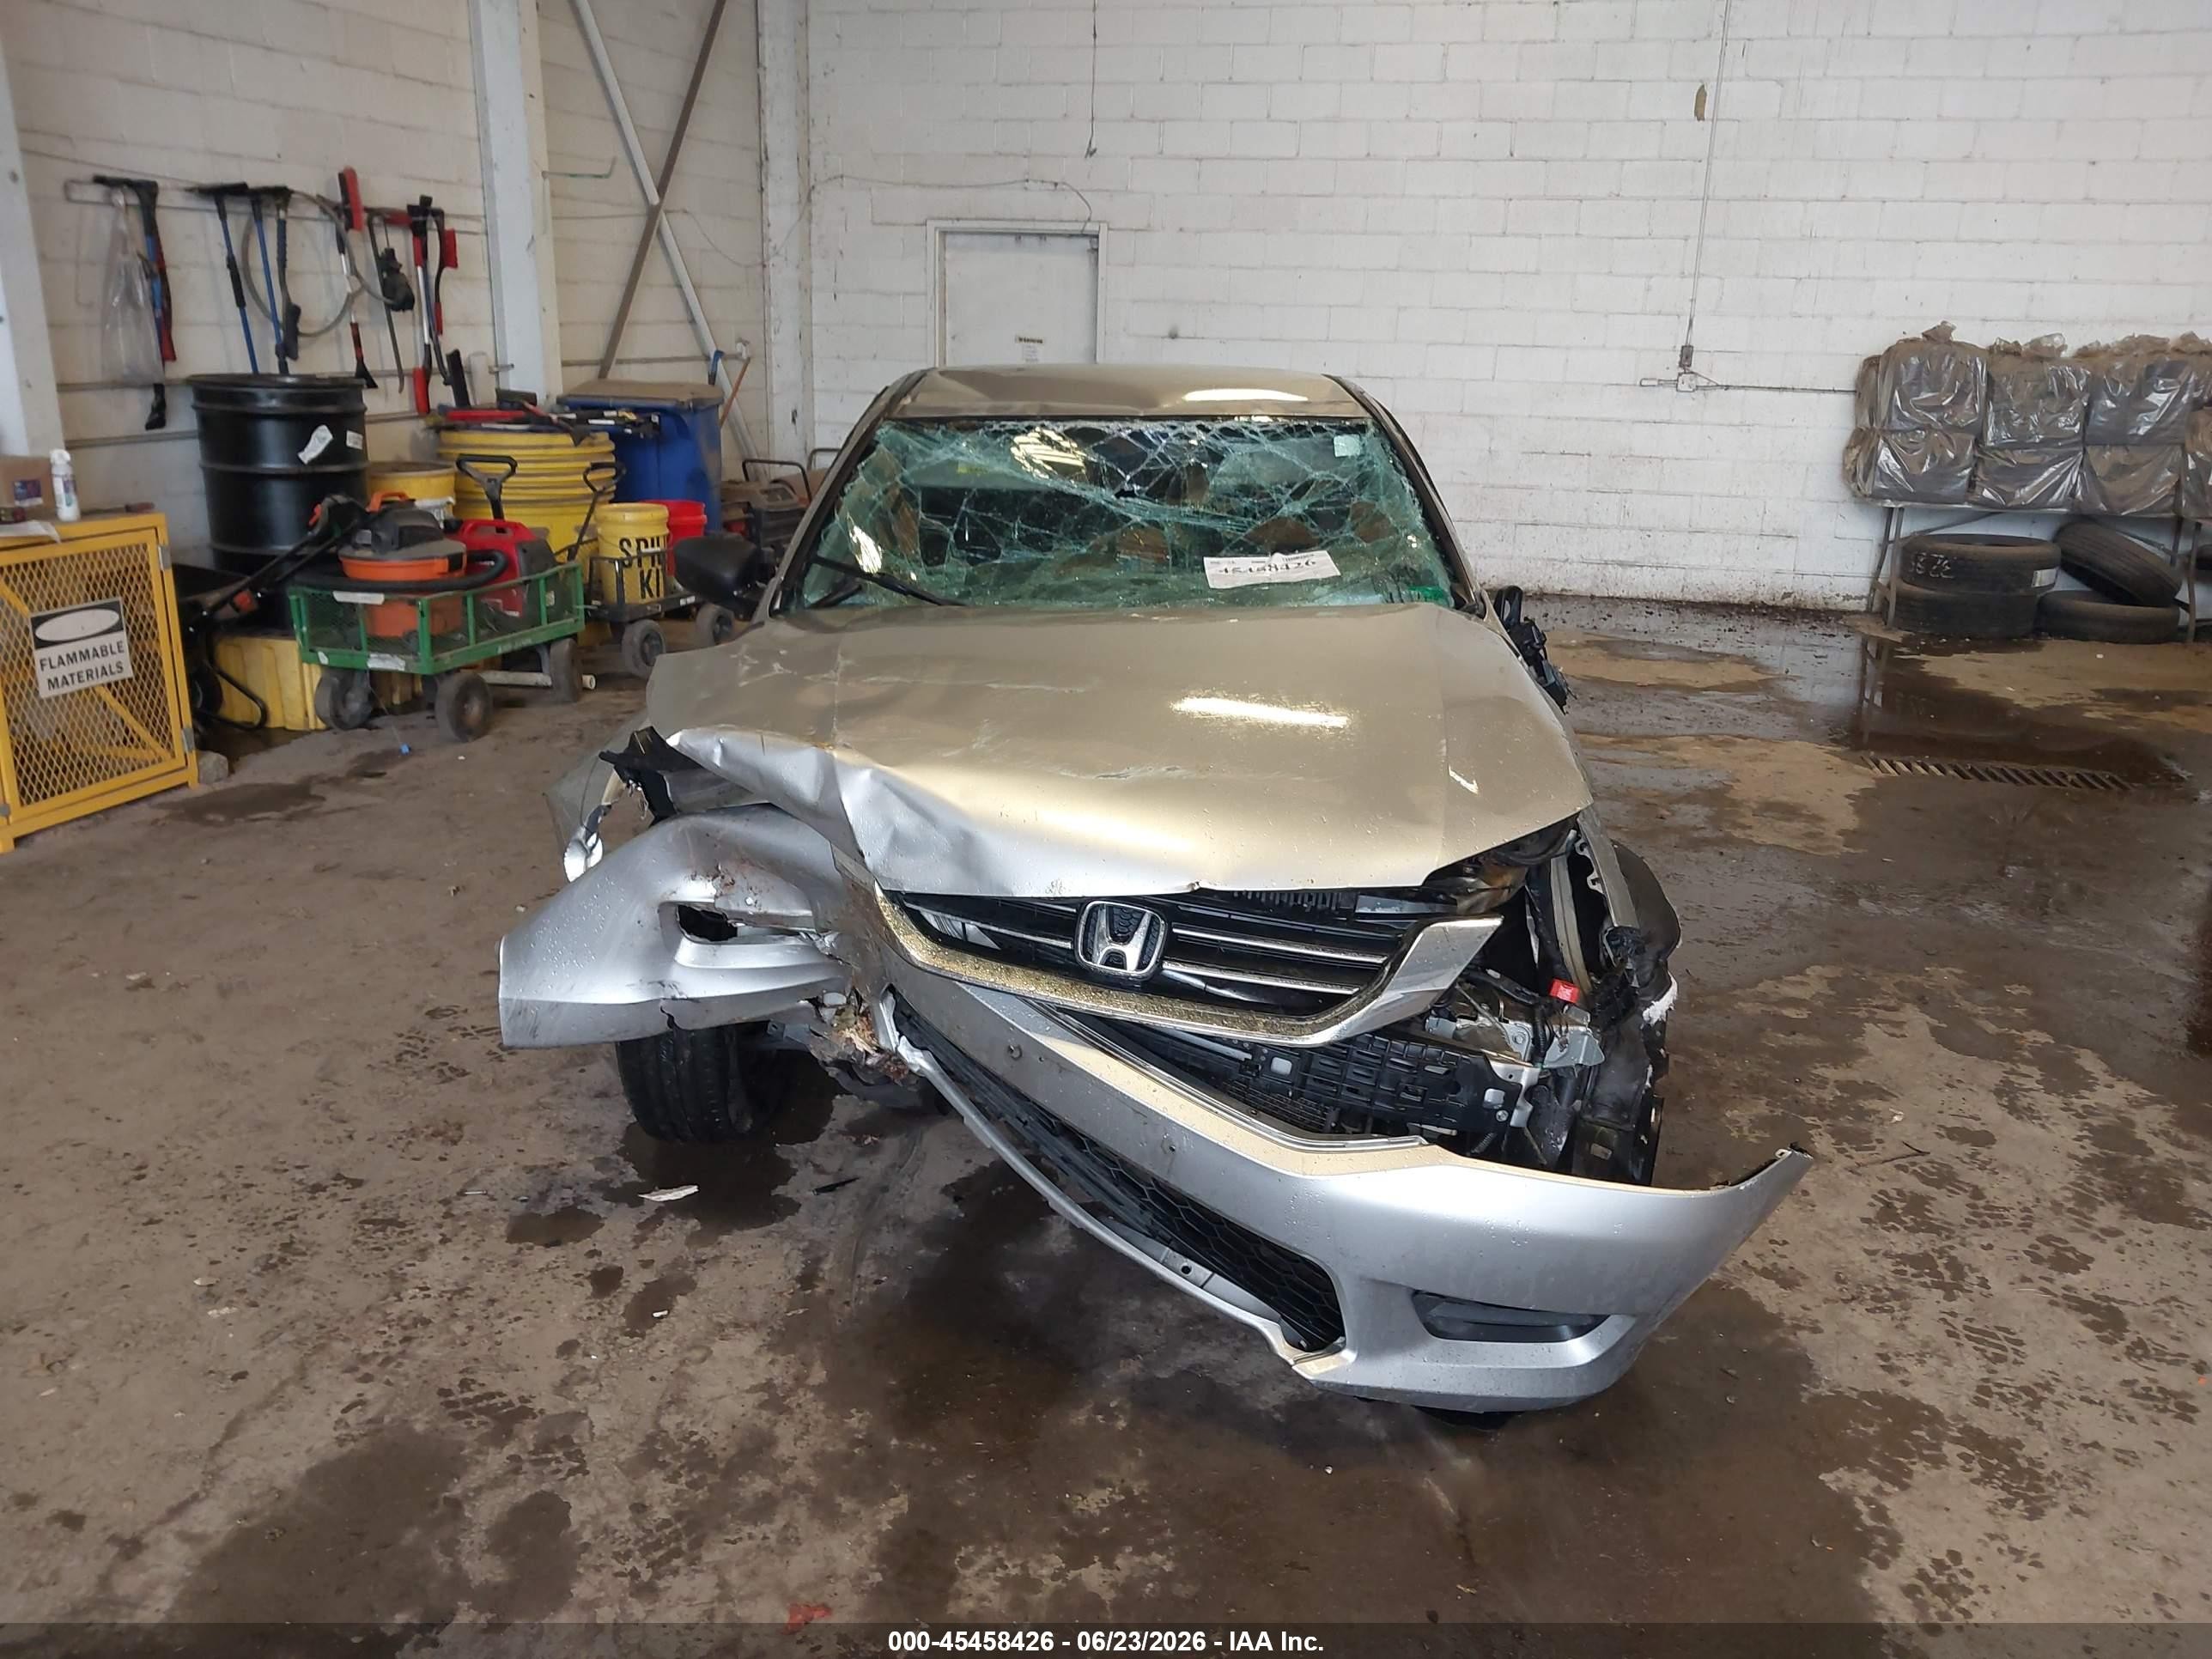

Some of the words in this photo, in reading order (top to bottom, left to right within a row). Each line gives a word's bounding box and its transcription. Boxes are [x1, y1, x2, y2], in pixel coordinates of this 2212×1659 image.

[639, 568, 660, 599] KI
[40, 641, 125, 672] FLAMMABLE
[47, 660, 125, 691] MATERIALS
